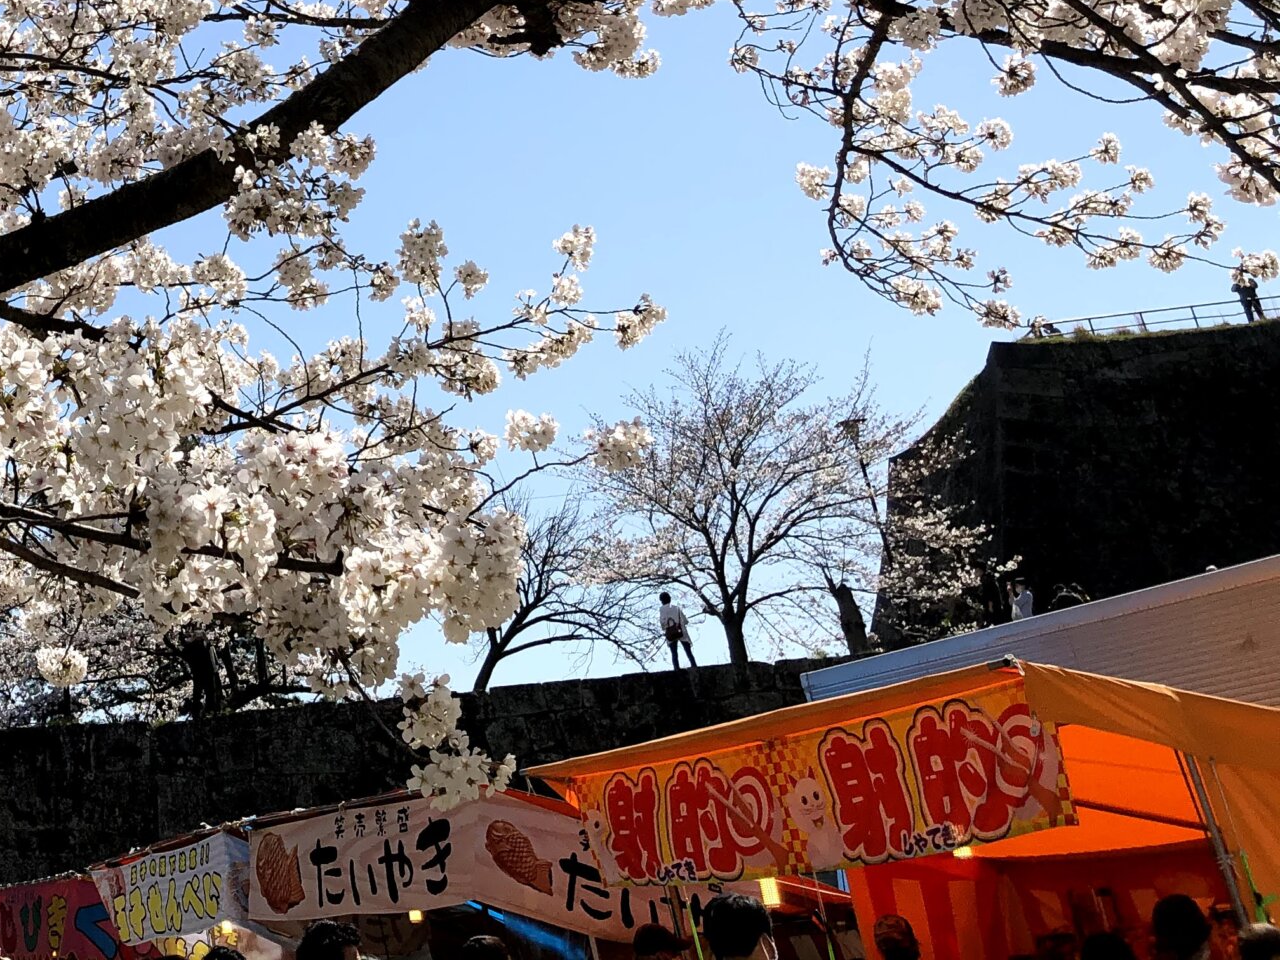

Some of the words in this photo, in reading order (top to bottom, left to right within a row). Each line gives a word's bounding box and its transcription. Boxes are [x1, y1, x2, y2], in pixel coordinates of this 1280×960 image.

[604, 758, 744, 885] 射的
[819, 700, 1014, 863] 射的
[113, 871, 222, 942] 玉子せんべい
[309, 816, 452, 908] たいやき
